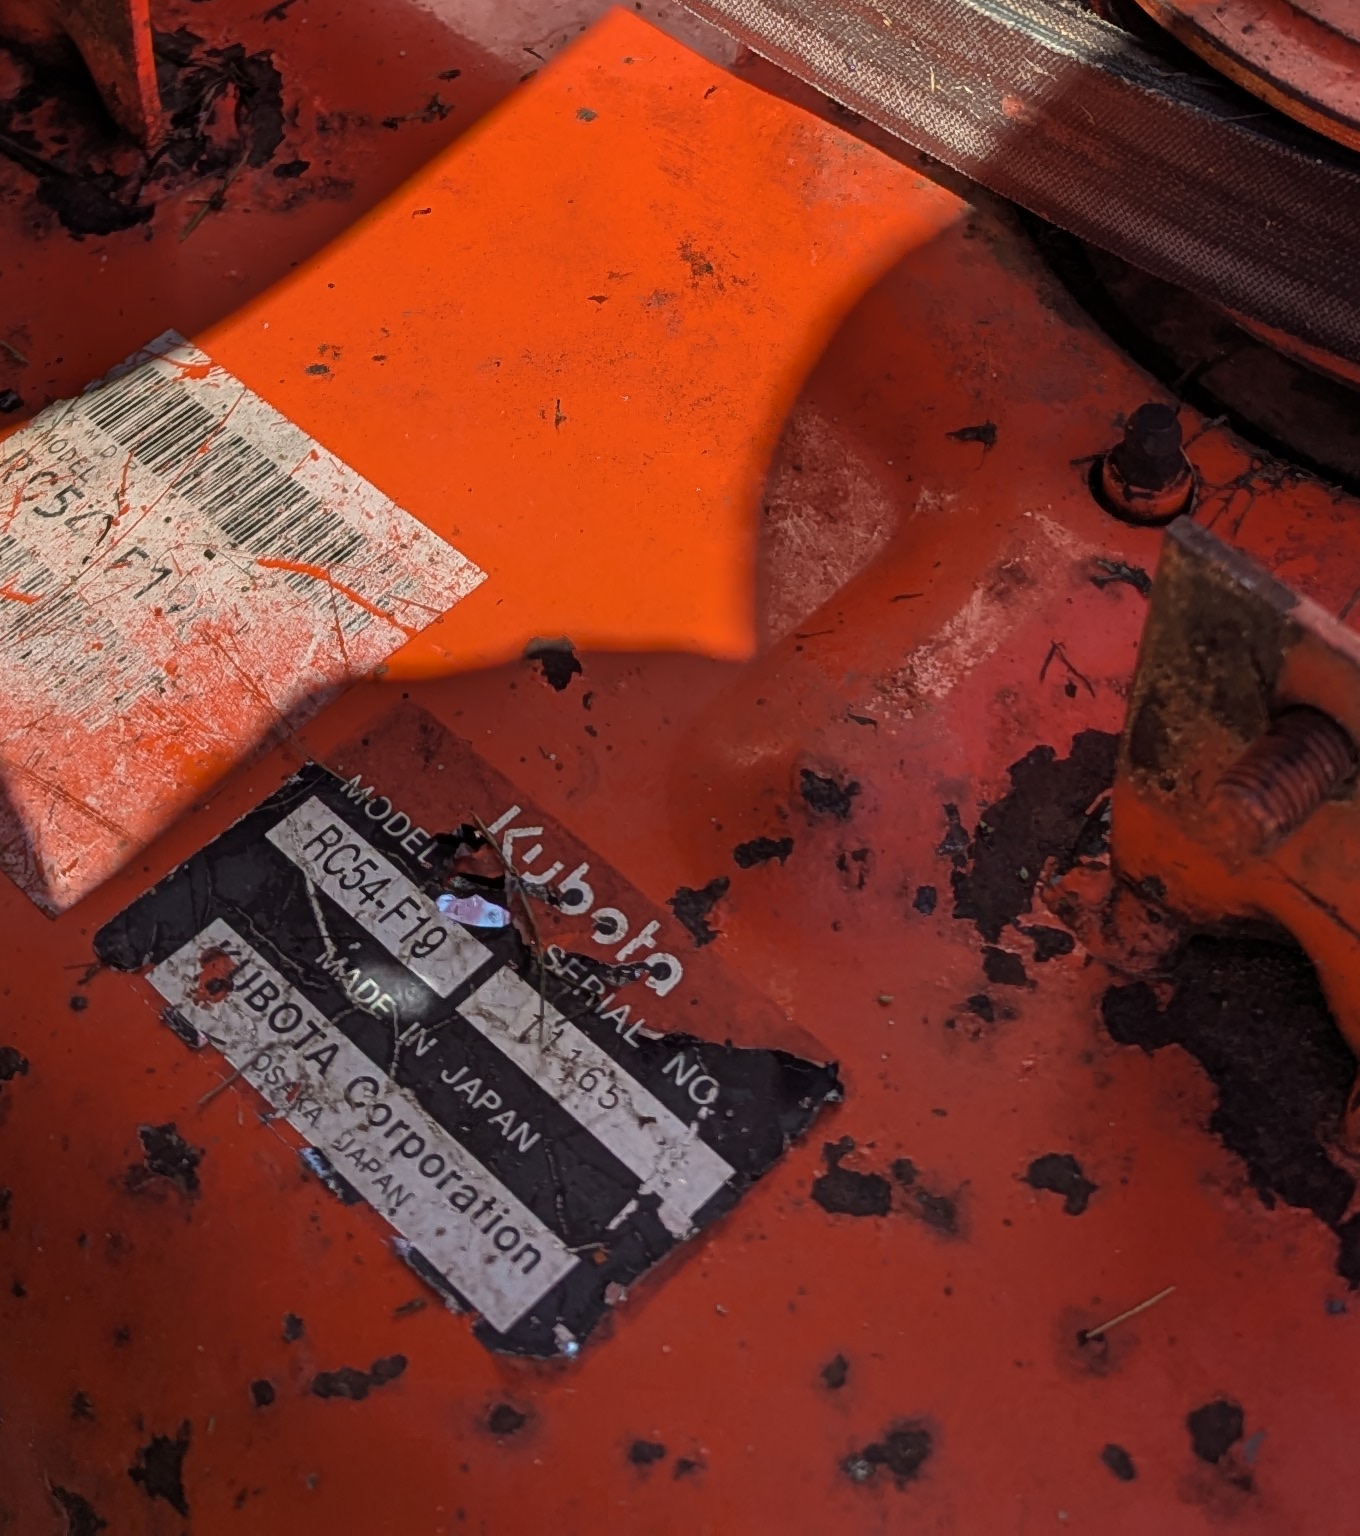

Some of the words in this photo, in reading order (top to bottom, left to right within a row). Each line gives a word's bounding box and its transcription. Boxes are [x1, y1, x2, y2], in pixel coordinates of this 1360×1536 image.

[301, 828, 450, 962] RC54-F19
[338, 775, 439, 866] MODEL
[481, 802, 682, 1000] Kubota
[313, 946, 397, 1021] MADE
[396, 1020, 437, 1058] IN
[438, 1059, 541, 1154] JAPAN
[331, 1137, 414, 1208] JAPAN
[338, 1069, 547, 1276] Corporation
